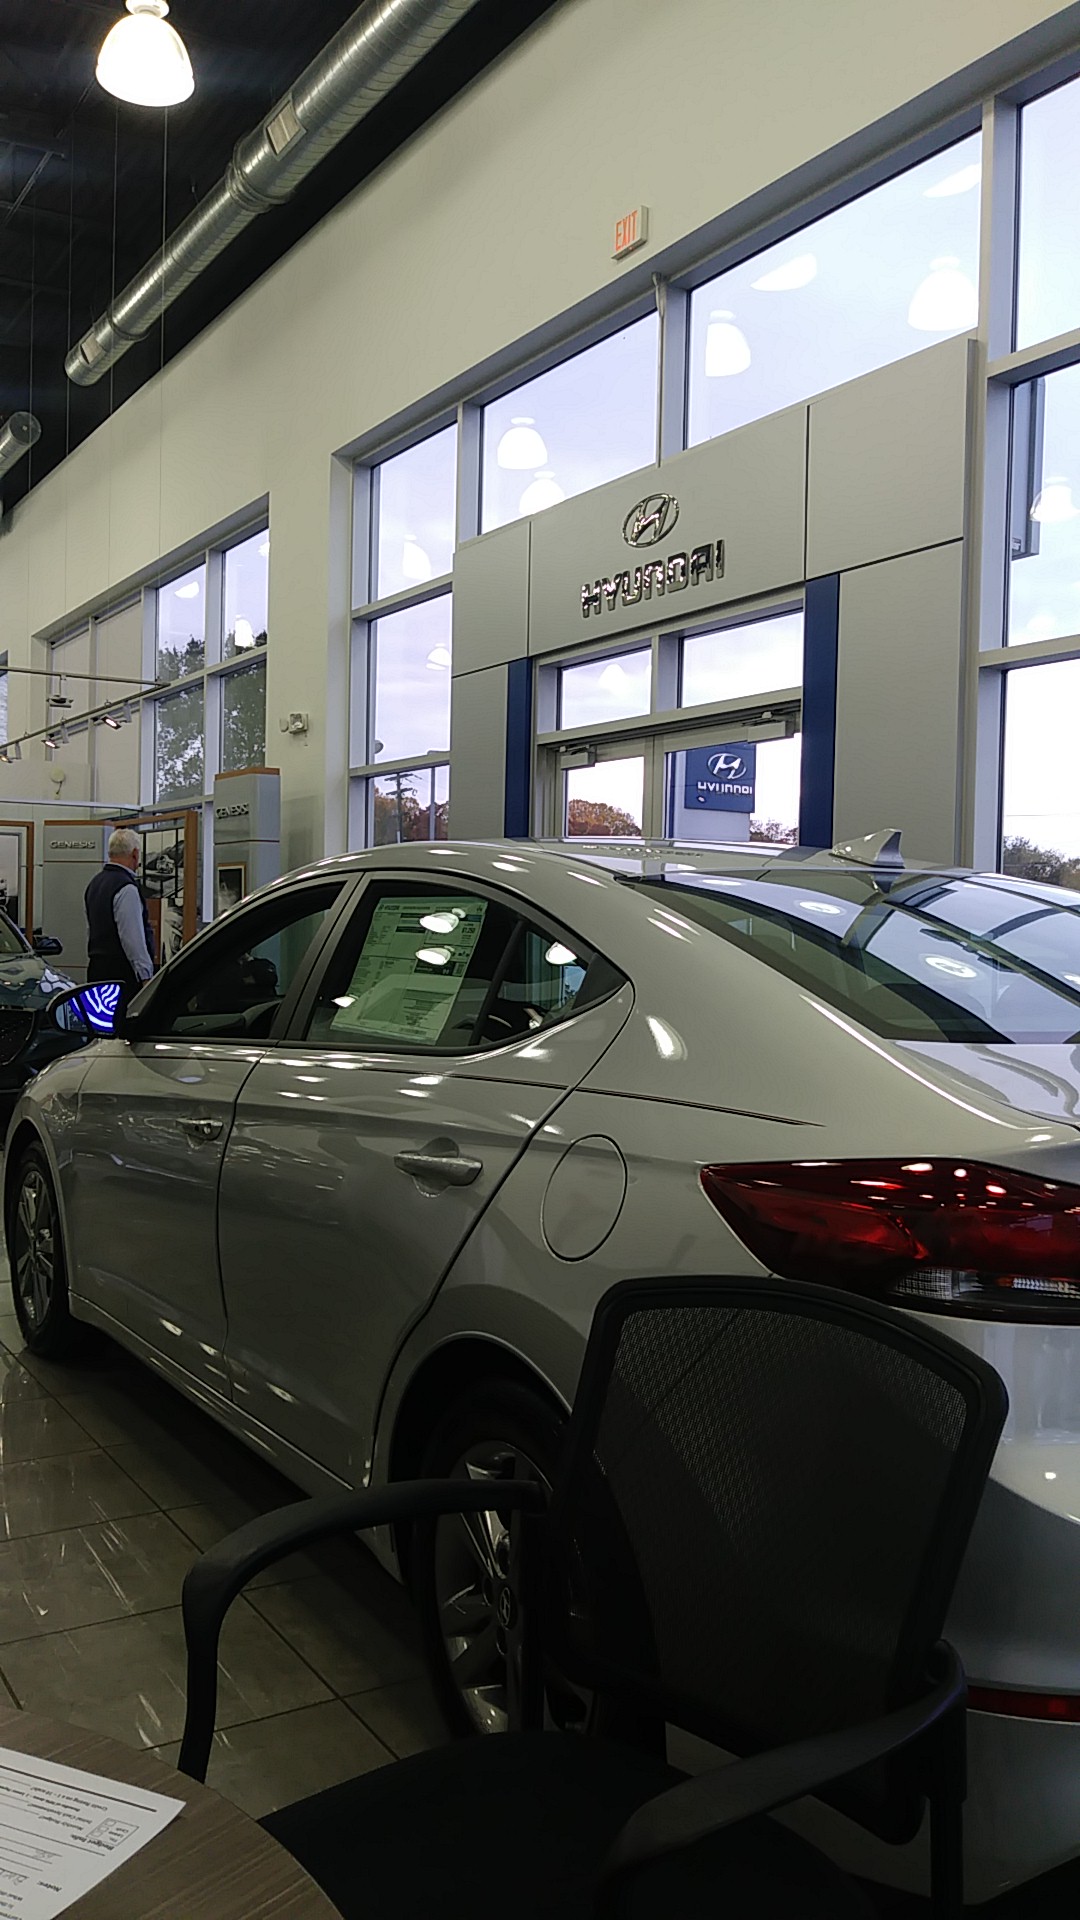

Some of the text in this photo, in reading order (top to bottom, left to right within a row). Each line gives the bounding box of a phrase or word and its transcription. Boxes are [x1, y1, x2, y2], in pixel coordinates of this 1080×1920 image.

[615, 210, 638, 252] EXIT
[580, 539, 725, 618] HYUNDAI
[50, 840, 96, 850] GENESIS
[38, 1815, 83, 1831] Monthly Budget?
[75, 1816, 92, 1824] Initial
[86, 1839, 114, 1850] Budget
[37, 1881, 62, 1892] Notes:
